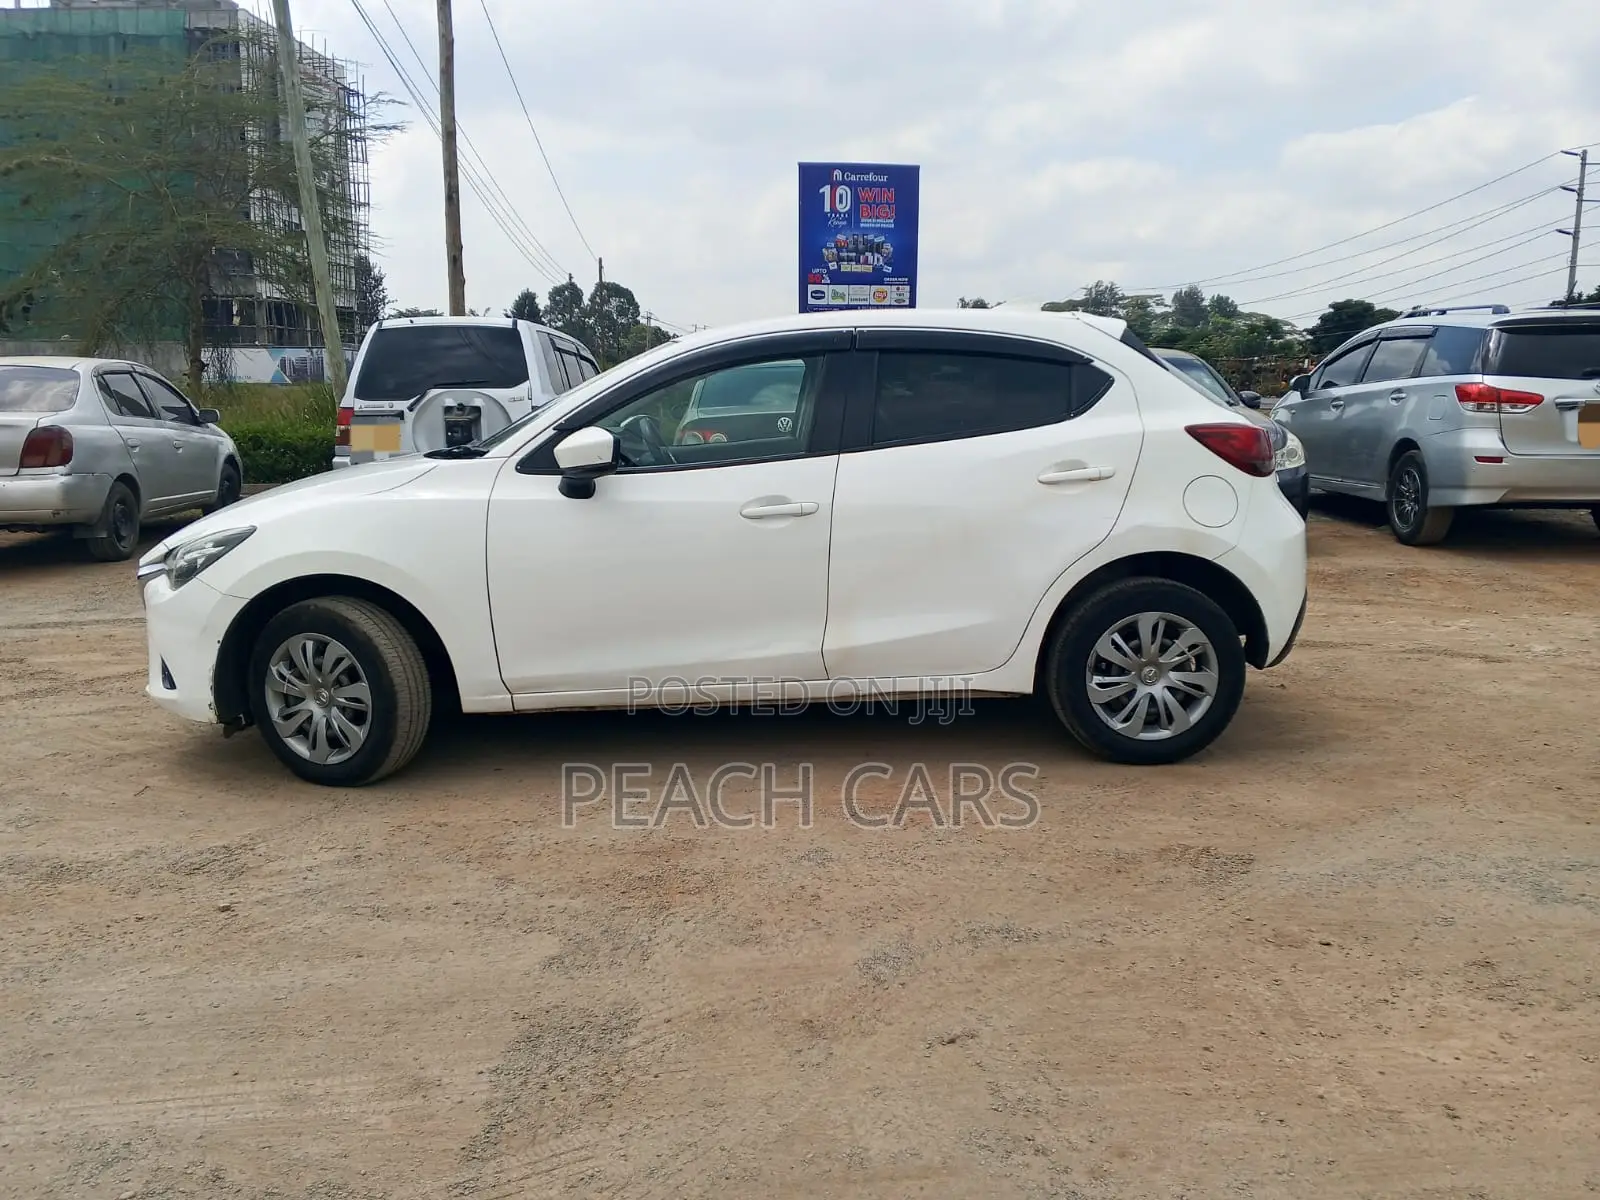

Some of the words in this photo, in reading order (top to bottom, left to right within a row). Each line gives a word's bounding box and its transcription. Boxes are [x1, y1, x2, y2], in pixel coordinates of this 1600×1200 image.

[844, 172, 888, 182] Carrefour
[819, 184, 851, 213] 10
[858, 187, 895, 203] WIN
[860, 204, 896, 219] BIG!
